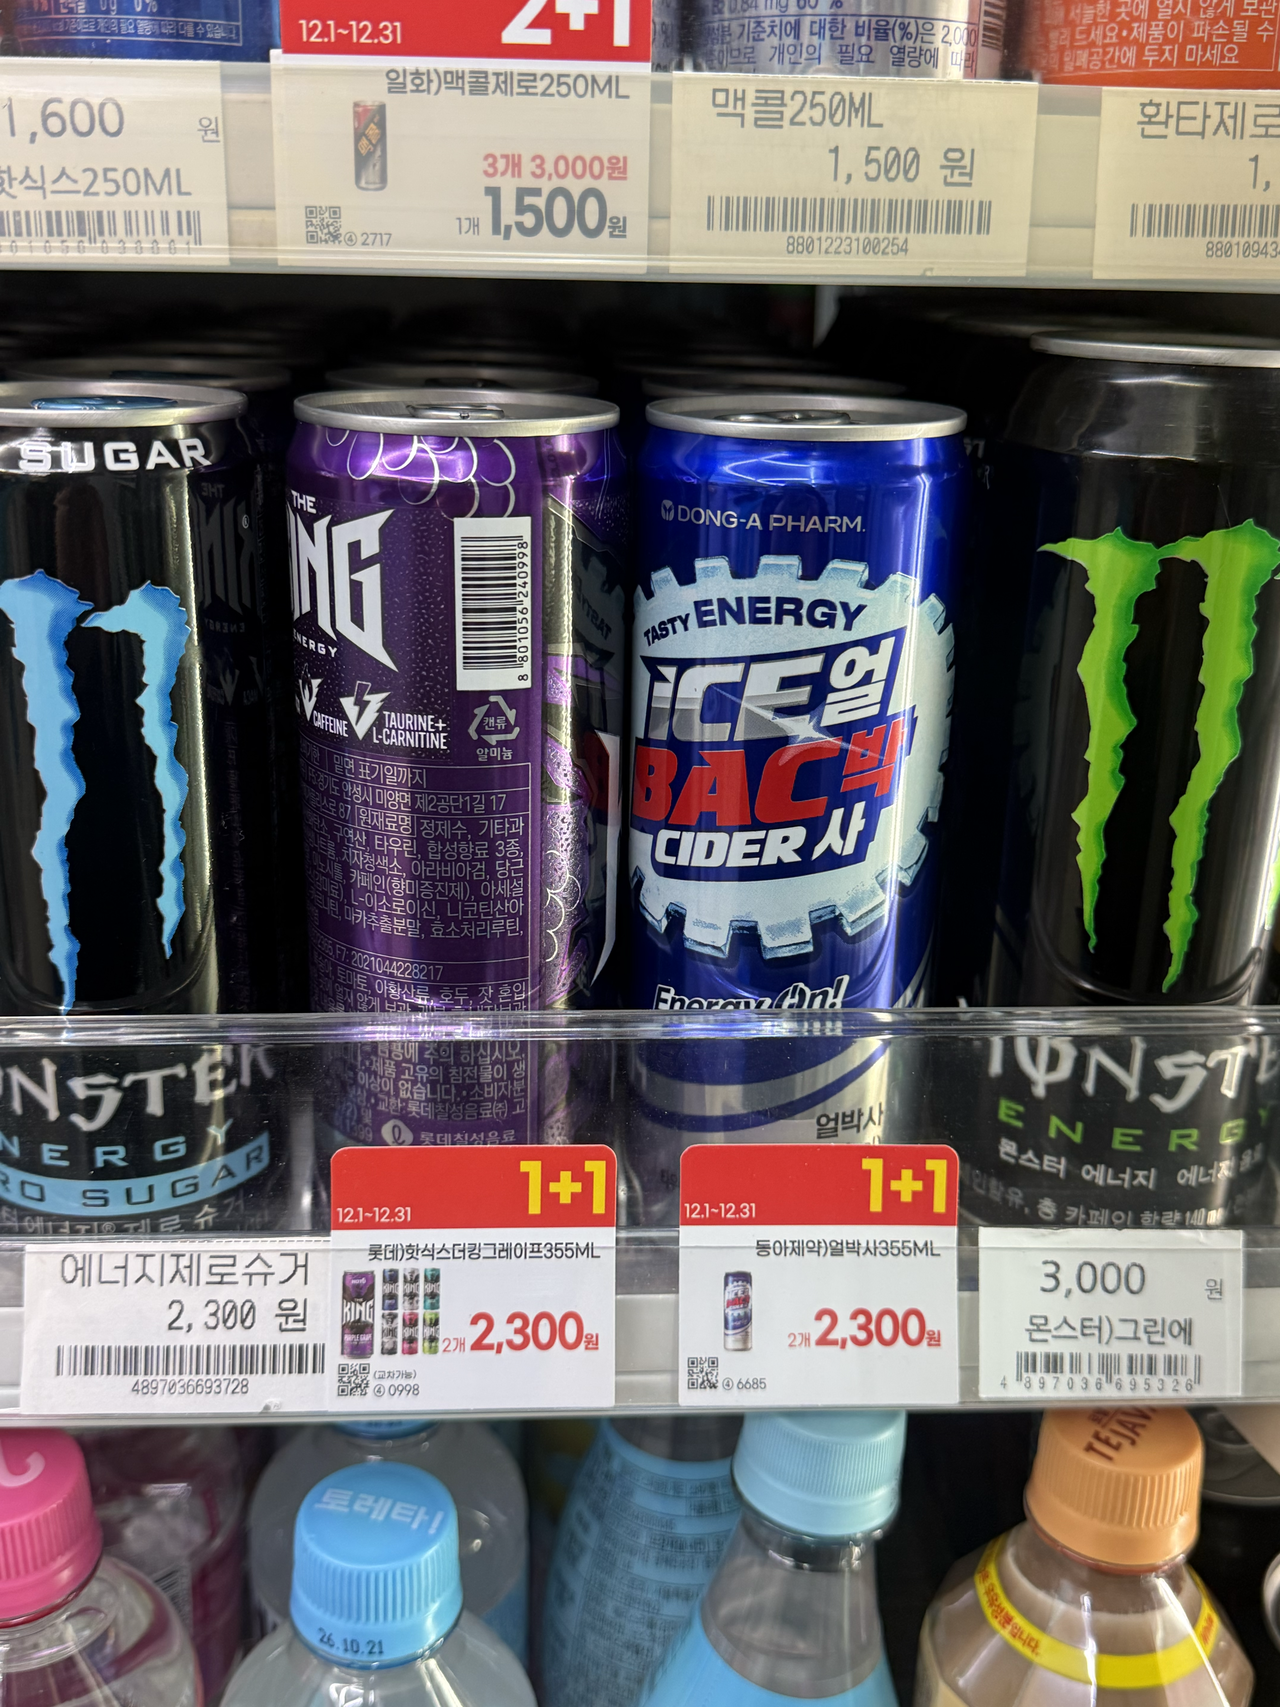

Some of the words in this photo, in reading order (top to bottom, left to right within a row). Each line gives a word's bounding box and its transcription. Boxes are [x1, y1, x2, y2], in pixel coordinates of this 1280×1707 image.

[298, 19, 402, 45] 12.1~12.31
[738, 19, 800, 42] 기준치에
[809, 18, 847, 42] 대한
[1192, 20, 1249, 43] 파손될
[1256, 20, 1275, 43] 수
[769, 43, 822, 66] 개인의
[838, 46, 874, 67] 필요
[889, 46, 939, 70] 열량에
[1143, 45, 1178, 68] 두지
[1185, 44, 1239, 67] 마세요
[385, 67, 631, 100] 일화)맥콜제로250ML
[2, 96, 126, 145] 1,600
[196, 115, 221, 144] 원
[711, 87, 884, 130] 맥콜250ML
[1136, 98, 1280, 141] 환타제로
[482, 153, 522, 180] 3개
[530, 155, 629, 182] 3,000원
[827, 144, 921, 186] 1,500
[938, 147, 976, 188] 원
[360, 232, 393, 247] 2717
[455, 216, 481, 238] 1개
[786, 235, 910, 257] 8801223100254
[18, 437, 213, 472] SUGAR
[290, 489, 317, 515] THE
[677, 503, 763, 532] DONG-A
[768, 513, 867, 534] PHARM.
[286, 501, 399, 673] ING
[643, 612, 691, 648] TASTY
[691, 595, 868, 632] ENERGY
[819, 635, 897, 728] 얼
[312, 709, 349, 738] CAFFEINE
[382, 710, 448, 732] TAURINE+
[483, 715, 508, 731] 캔류
[371, 726, 449, 750] L-CARNITINE
[475, 747, 514, 762] 알미늄
[333, 754, 355, 778] 밑면
[358, 761, 427, 789] 표기일까지
[840, 716, 909, 798] 박
[341, 780, 373, 807] 안성시
[375, 788, 412, 812] 미양면
[414, 792, 486, 814] 제2공단1길
[489, 792, 507, 811] 17
[632, 736, 843, 827] BAC
[358, 807, 412, 835] 원재료명
[419, 818, 472, 841] 정제수,
[478, 816, 526, 840] 기타과
[811, 800, 867, 861] 사
[332, 822, 370, 853] 구연산,
[374, 834, 422, 860] 타우린,
[426, 840, 490, 861] 합성향료
[494, 838, 524, 858] 3종,
[654, 825, 808, 868] CIDER
[341, 846, 406, 879] 치자청색소,
[411, 859, 490, 881] 아라비아검,
[495, 858, 525, 879] 당근
[350, 887, 440, 920] L-이소로이신,
[446, 897, 525, 921] 니코틴산아
[480, 877, 525, 899] 아세설
[343, 903, 425, 939] 마카추출분말,
[429, 917, 524, 940] 효소처리루틴,
[336, 965, 372, 997] 토마토,
[477, 985, 494, 1005] 잣
[497, 981, 527, 1004] 혼입
[0, 1042, 276, 1133] NSTER
[400, 1062, 443, 1084] 고유의
[448, 1062, 507, 1084] 침전물이
[511, 1059, 526, 1079] 생
[986, 1036, 1280, 1115] ONST
[511, 1098, 526, 1115] 고
[815, 1101, 884, 1140] 얼박사
[80, 1141, 265, 1209] SUGAR
[998, 1137, 1067, 1180] 몬스터
[1080, 1162, 1157, 1191] 에너지
[336, 1206, 412, 1224] 12.1~12.31
[519, 1159, 607, 1216] 1+1
[684, 1202, 757, 1219] 12.1~12.31
[861, 1157, 948, 1214] 1+1
[1064, 1206, 1133, 1228] 카페인
[367, 1240, 602, 1263] 롯데)핫식스더킹그레이프355ML
[754, 1238, 942, 1258] 동아제약)얼박사355ML
[60, 1252, 310, 1288] 에너지제로슈거
[1039, 1258, 1147, 1299] 3,000
[1203, 1277, 1224, 1301] 원
[167, 1298, 257, 1334] 2,300
[274, 1297, 309, 1333] 원
[342, 1299, 374, 1324] KING
[441, 1337, 467, 1354] 2개
[786, 1332, 812, 1349] 2개
[1024, 1314, 1194, 1346] 몬스터)그린에
[131, 1377, 250, 1396] 4897036693728
[373, 1369, 417, 1381] (교차가능)
[387, 1383, 420, 1398] 0998
[736, 1376, 767, 1391] 6685
[1083, 1405, 1158, 1462] TEJAV
[317, 1626, 385, 1656] 26.10.21
